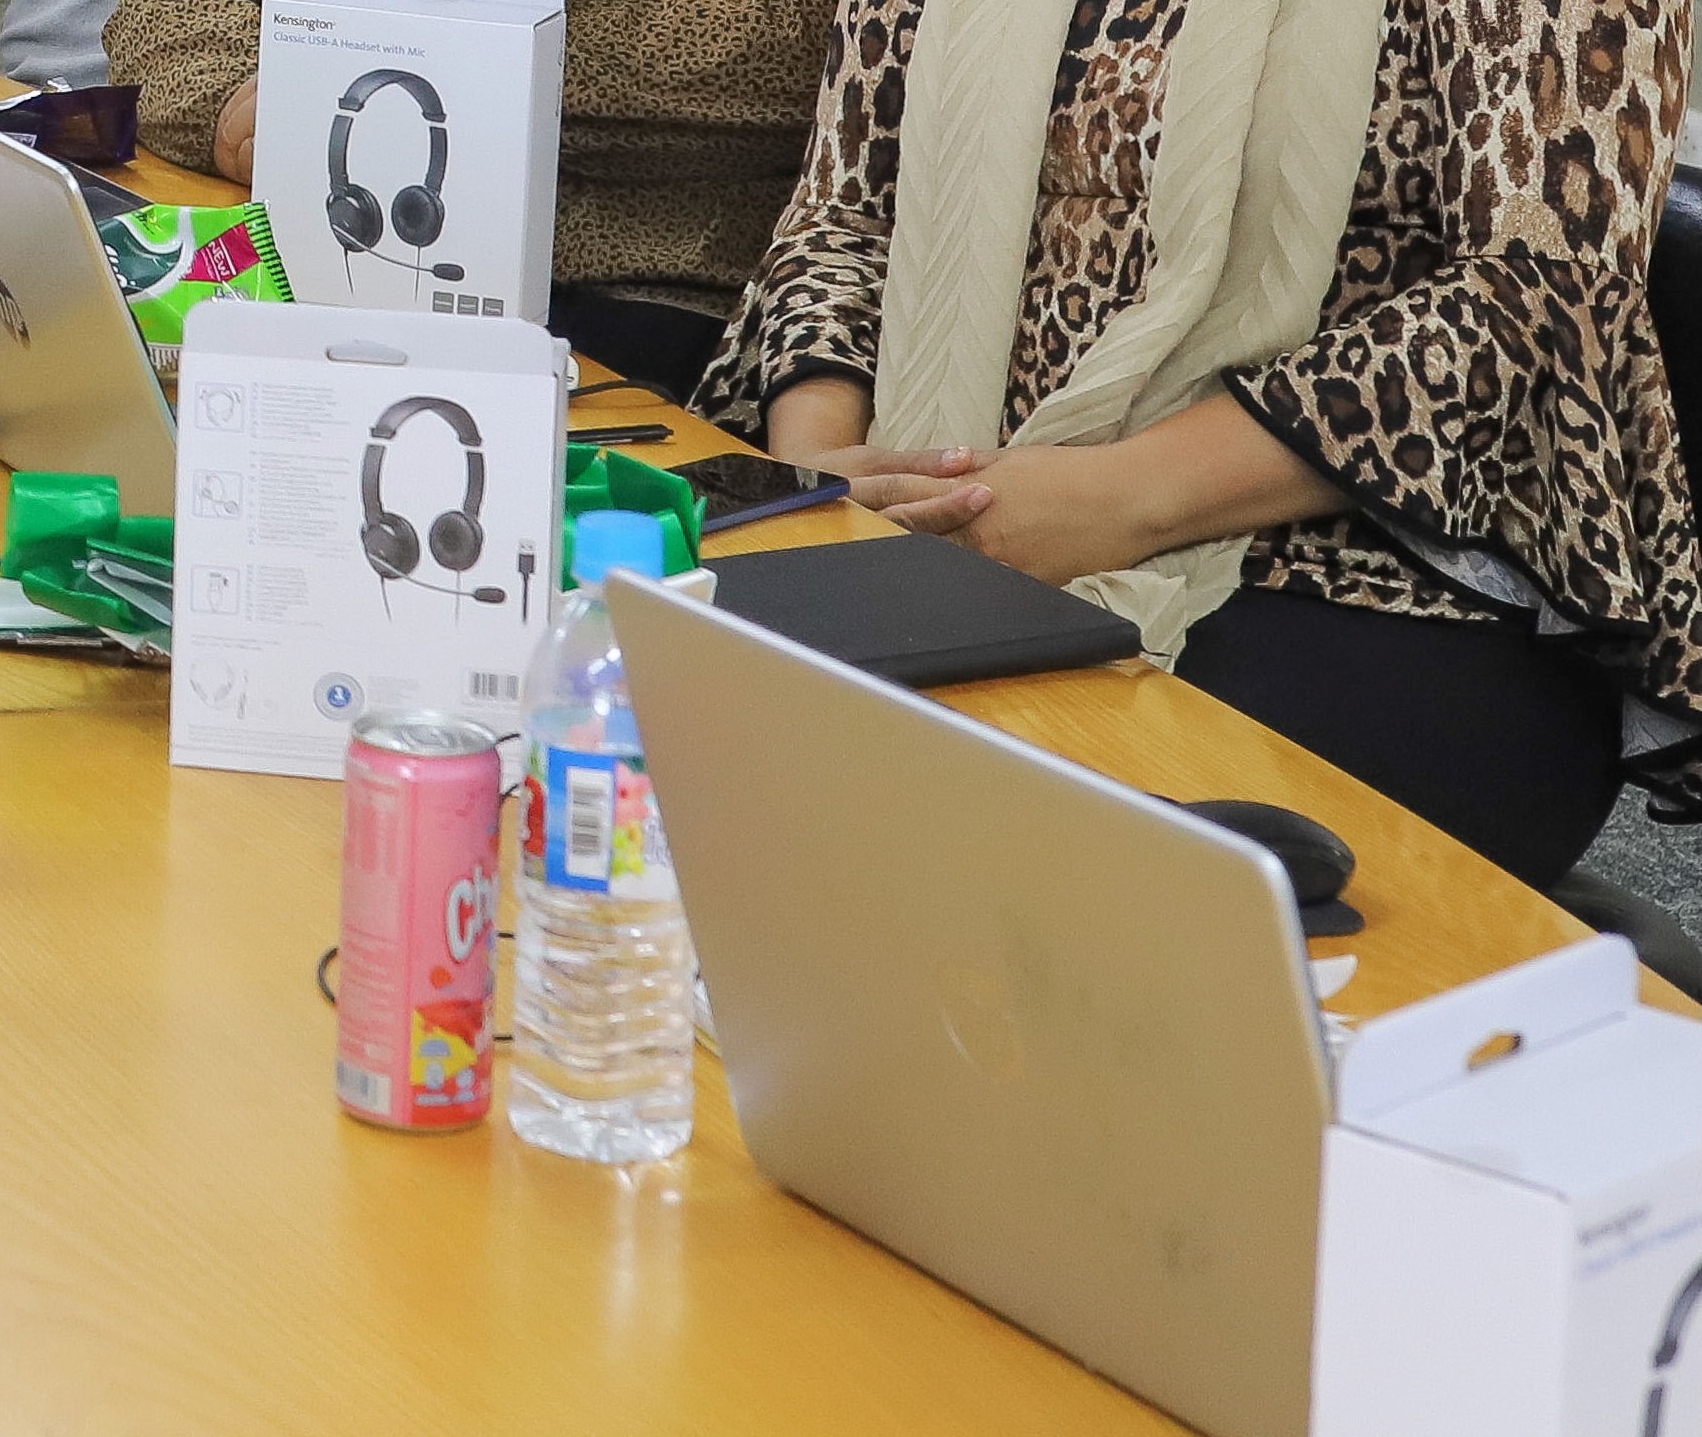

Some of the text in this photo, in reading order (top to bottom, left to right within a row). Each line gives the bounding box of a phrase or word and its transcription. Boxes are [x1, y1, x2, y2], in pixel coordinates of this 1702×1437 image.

[274, 13, 334, 31] Kensington
[273, 31, 426, 58] Classic USB-A Headset with Mic
[207, 241, 232, 278] NEW
